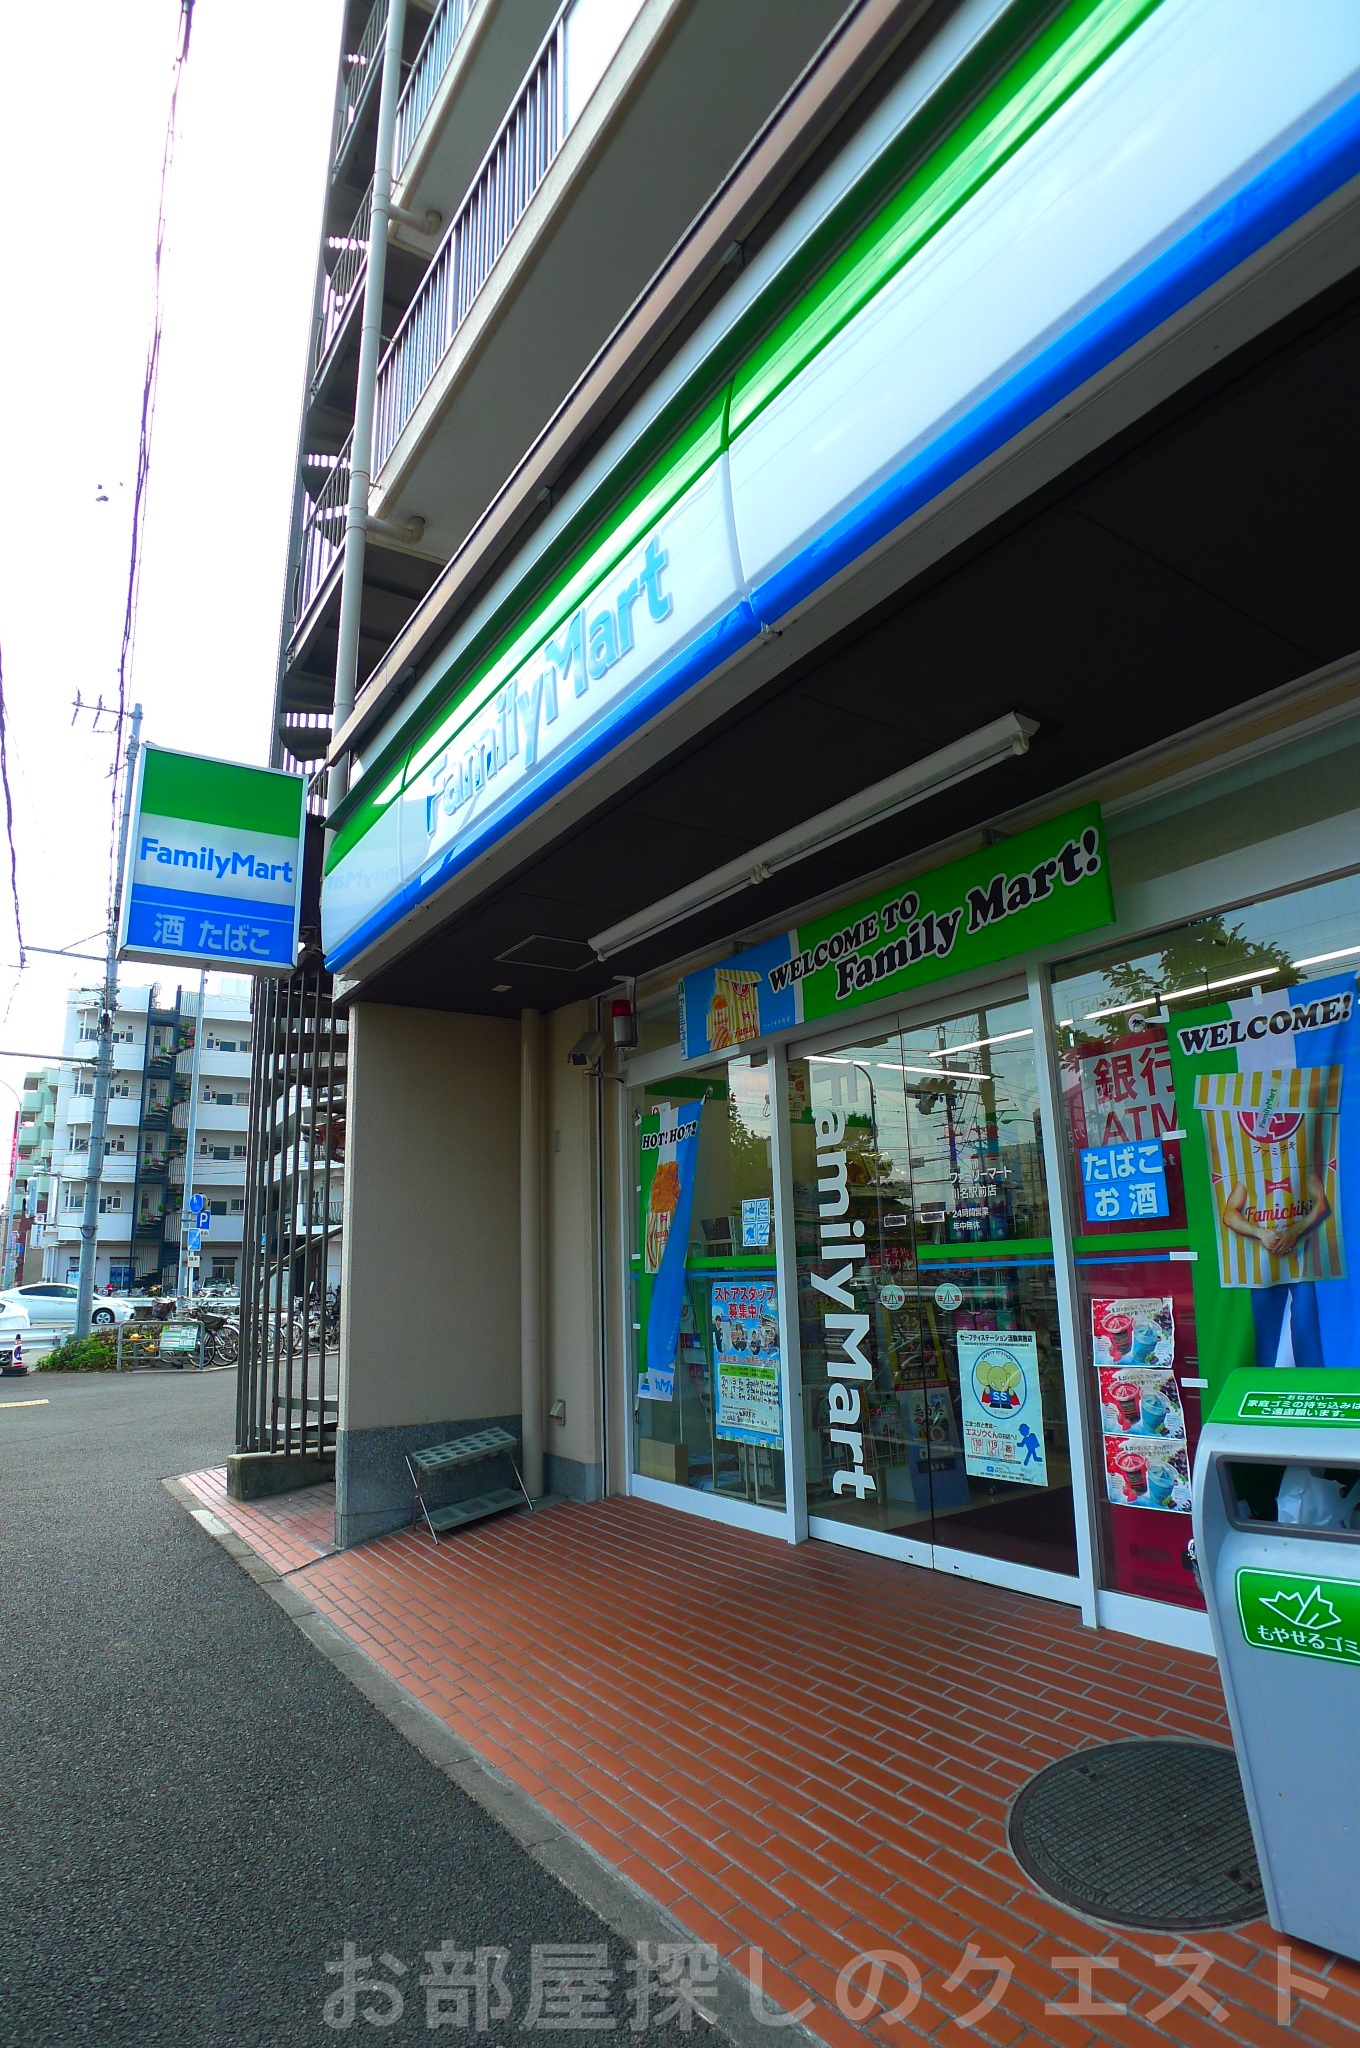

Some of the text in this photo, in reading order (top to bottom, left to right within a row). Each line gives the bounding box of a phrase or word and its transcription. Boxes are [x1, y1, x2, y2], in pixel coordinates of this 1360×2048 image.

[426, 534, 674, 836] FamilyMart
[140, 837, 293, 882] FamilyMart
[836, 827, 1099, 999] Family Mart!
[153, 913, 270, 955] 酒 たばこ
[769, 891, 919, 993] WELCOME TO
[679, 998, 687, 1057] FamilyMart
[1179, 994, 1352, 1054] WELCOME!
[1093, 1046, 1174, 1104] 銀行
[1102, 1100, 1178, 1147] ATM
[1259, 1088, 1277, 1128] FamilyMart
[642, 1132, 669, 1149] HOT!
[1252, 1141, 1296, 1157] ファミチキ
[1084, 1145, 1162, 1181] たばこ
[1095, 1182, 1158, 1217] お酒
[199, 1212, 208, 1228] P
[953, 1220, 981, 1231] 年中無休
[714, 1286, 776, 1302] ストアスタッフ
[810, 1060, 877, 1500] FamilyMart
[992, 1392, 1008, 1401] SS
[1261, 1407, 1346, 1418] ご遠慮願います。
[1257, 1625, 1360, 1656] もやせるゴミ
